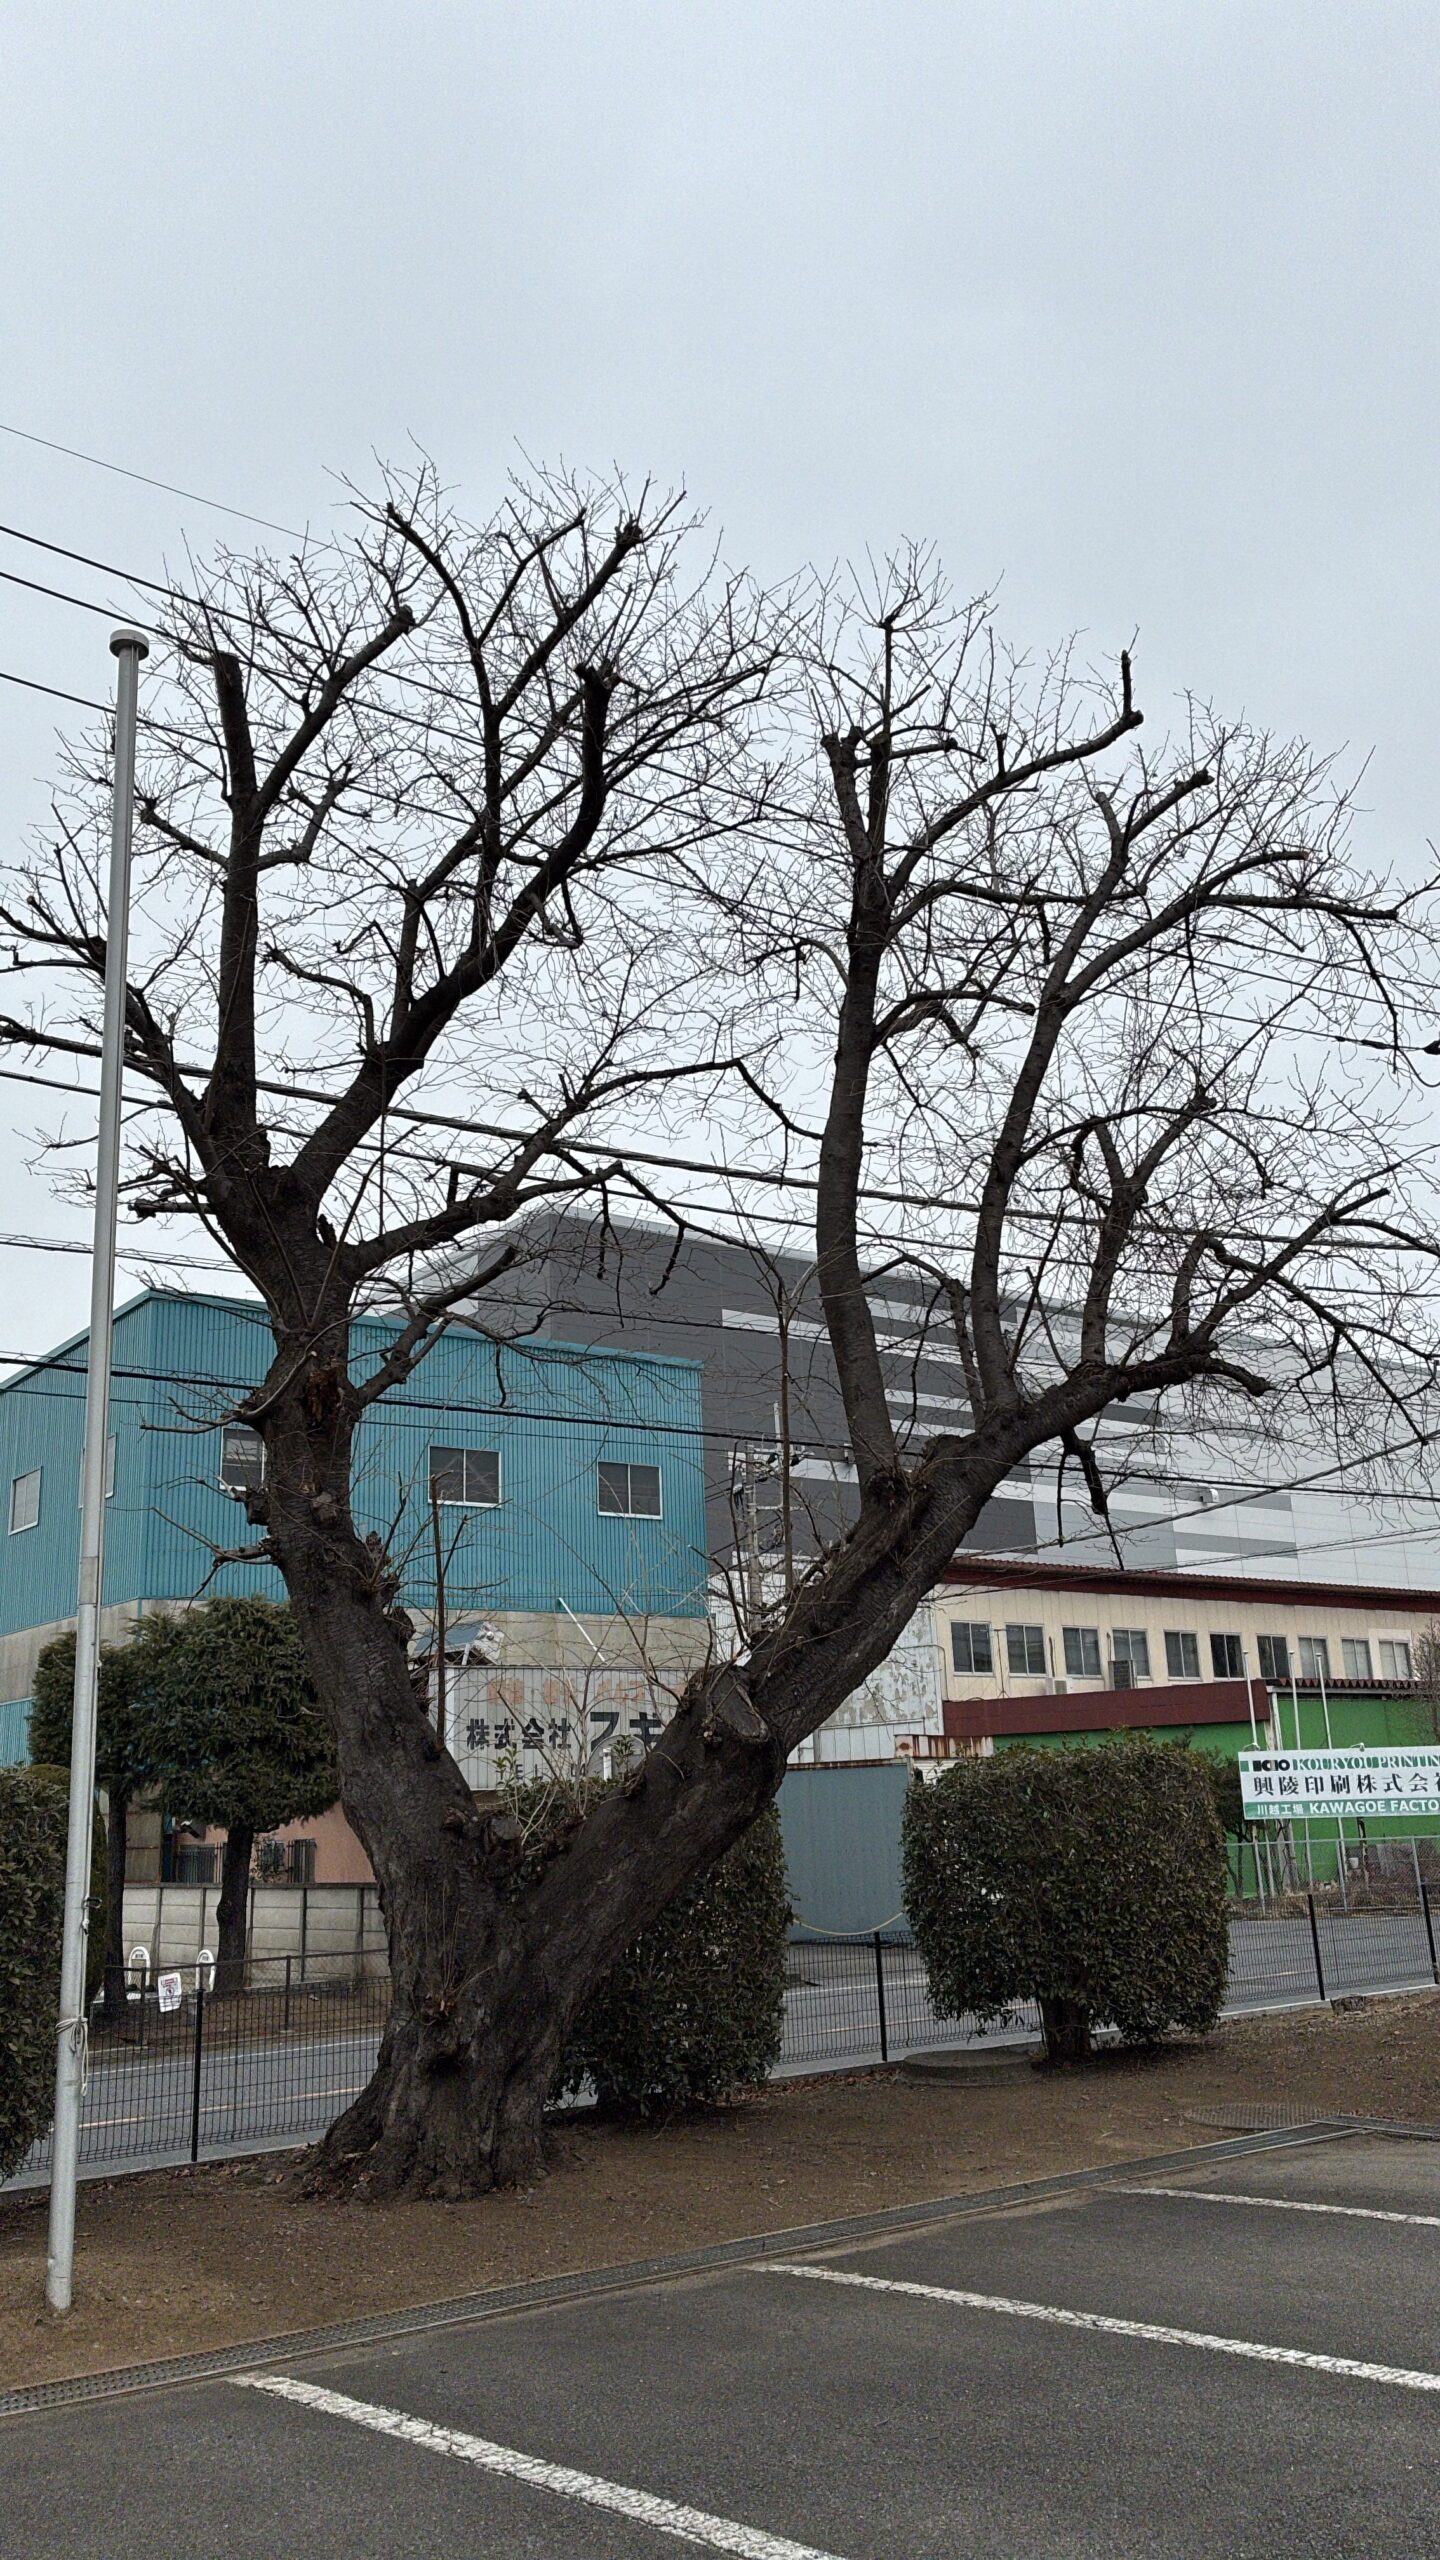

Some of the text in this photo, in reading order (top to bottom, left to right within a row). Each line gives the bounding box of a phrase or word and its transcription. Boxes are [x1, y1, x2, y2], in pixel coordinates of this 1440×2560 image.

[1296, 1756, 1374, 1771] KOURYOU
[1256, 1799, 1440, 1815] 川越工場 KAWAGOE FACTO
